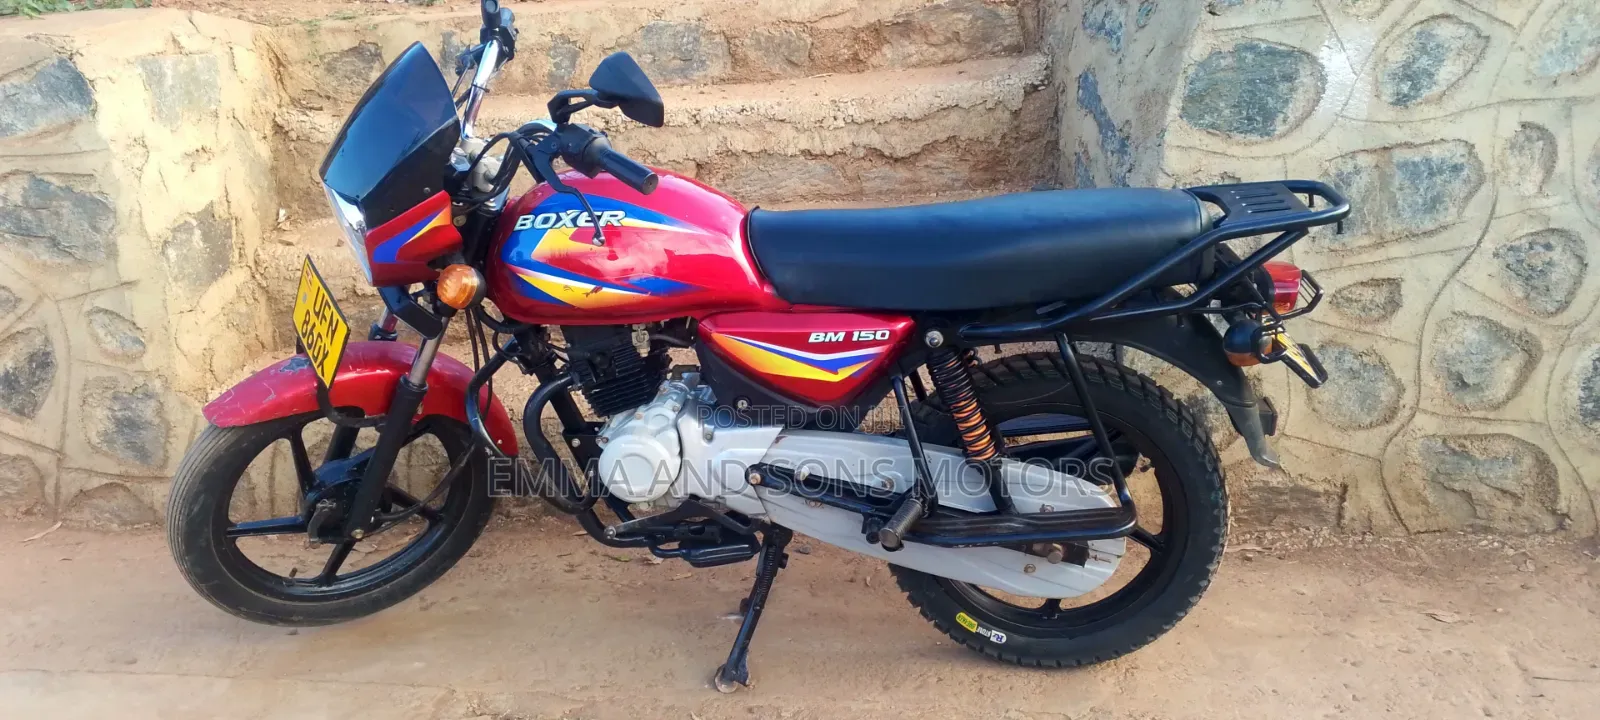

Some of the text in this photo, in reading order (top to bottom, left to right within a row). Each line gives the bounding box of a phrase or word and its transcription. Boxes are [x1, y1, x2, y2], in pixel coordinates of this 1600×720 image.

[514, 209, 626, 231] BOXER
[313, 286, 339, 345] UFN
[808, 329, 890, 343] BM 150
